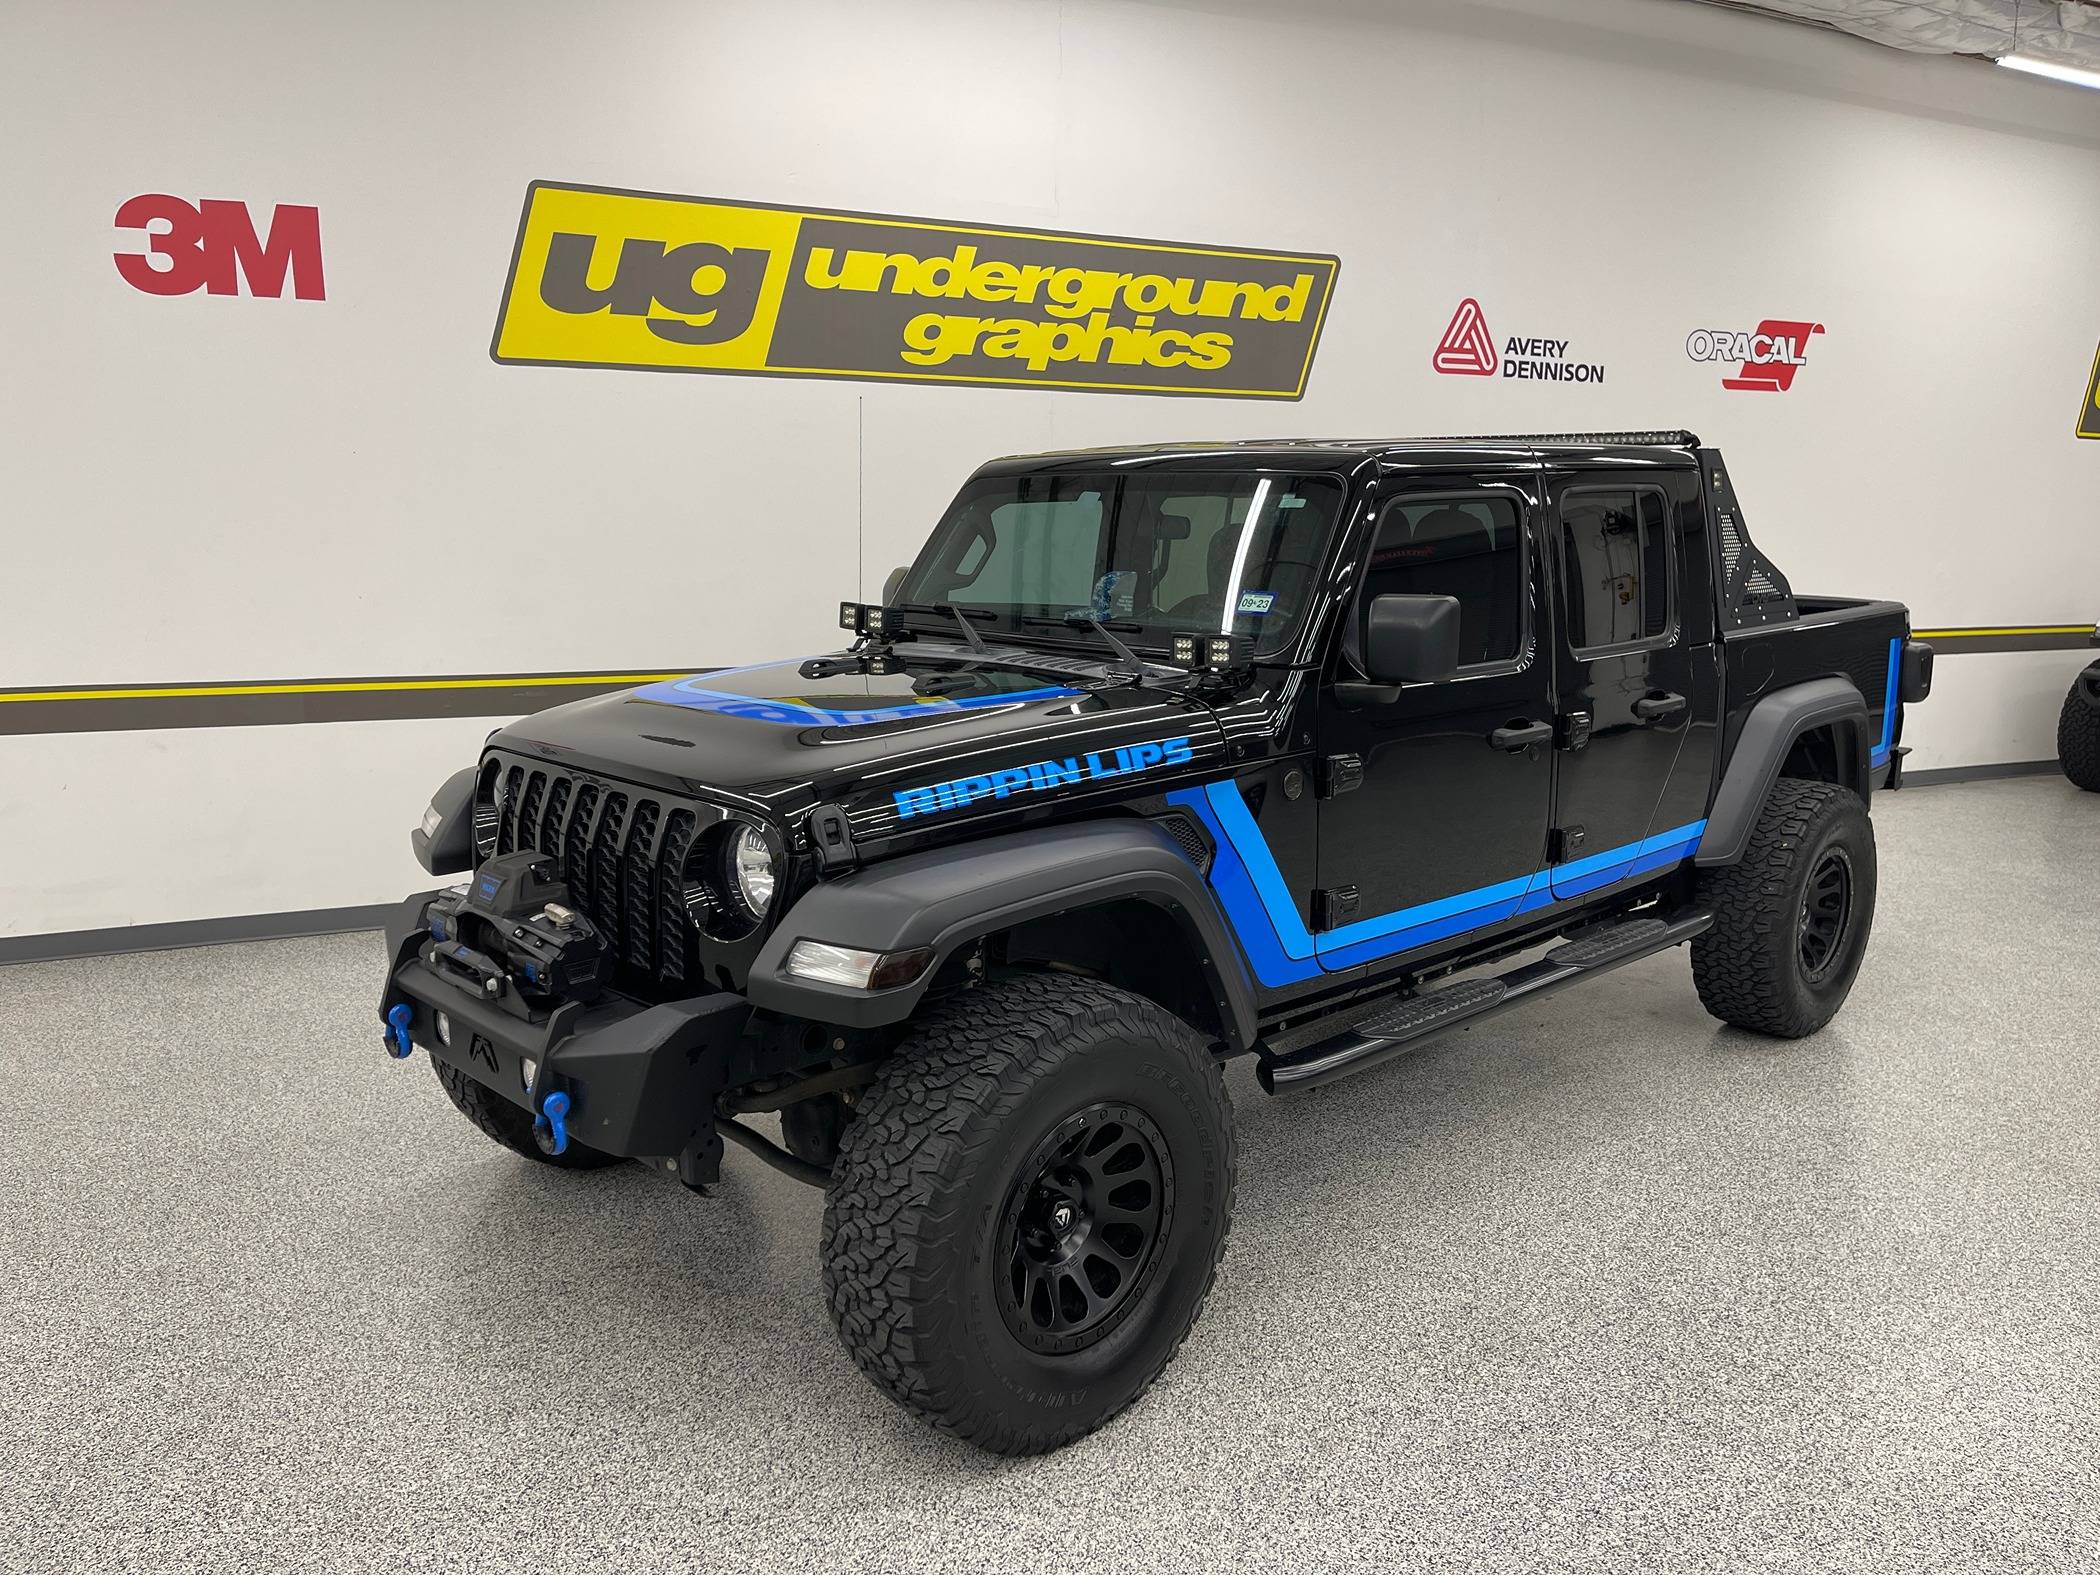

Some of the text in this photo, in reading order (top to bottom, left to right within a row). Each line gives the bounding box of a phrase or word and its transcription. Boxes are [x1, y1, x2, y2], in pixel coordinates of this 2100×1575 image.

[114, 194, 326, 301] 3M
[541, 233, 770, 344] ug
[803, 244, 1314, 323] underground
[901, 312, 1234, 371] graphics
[1503, 359, 1605, 383] DENNISON
[1504, 336, 1569, 358] AVERY
[1685, 329, 1807, 366] ORACAL
[893, 737, 1194, 819] RIPPIN LIPS
